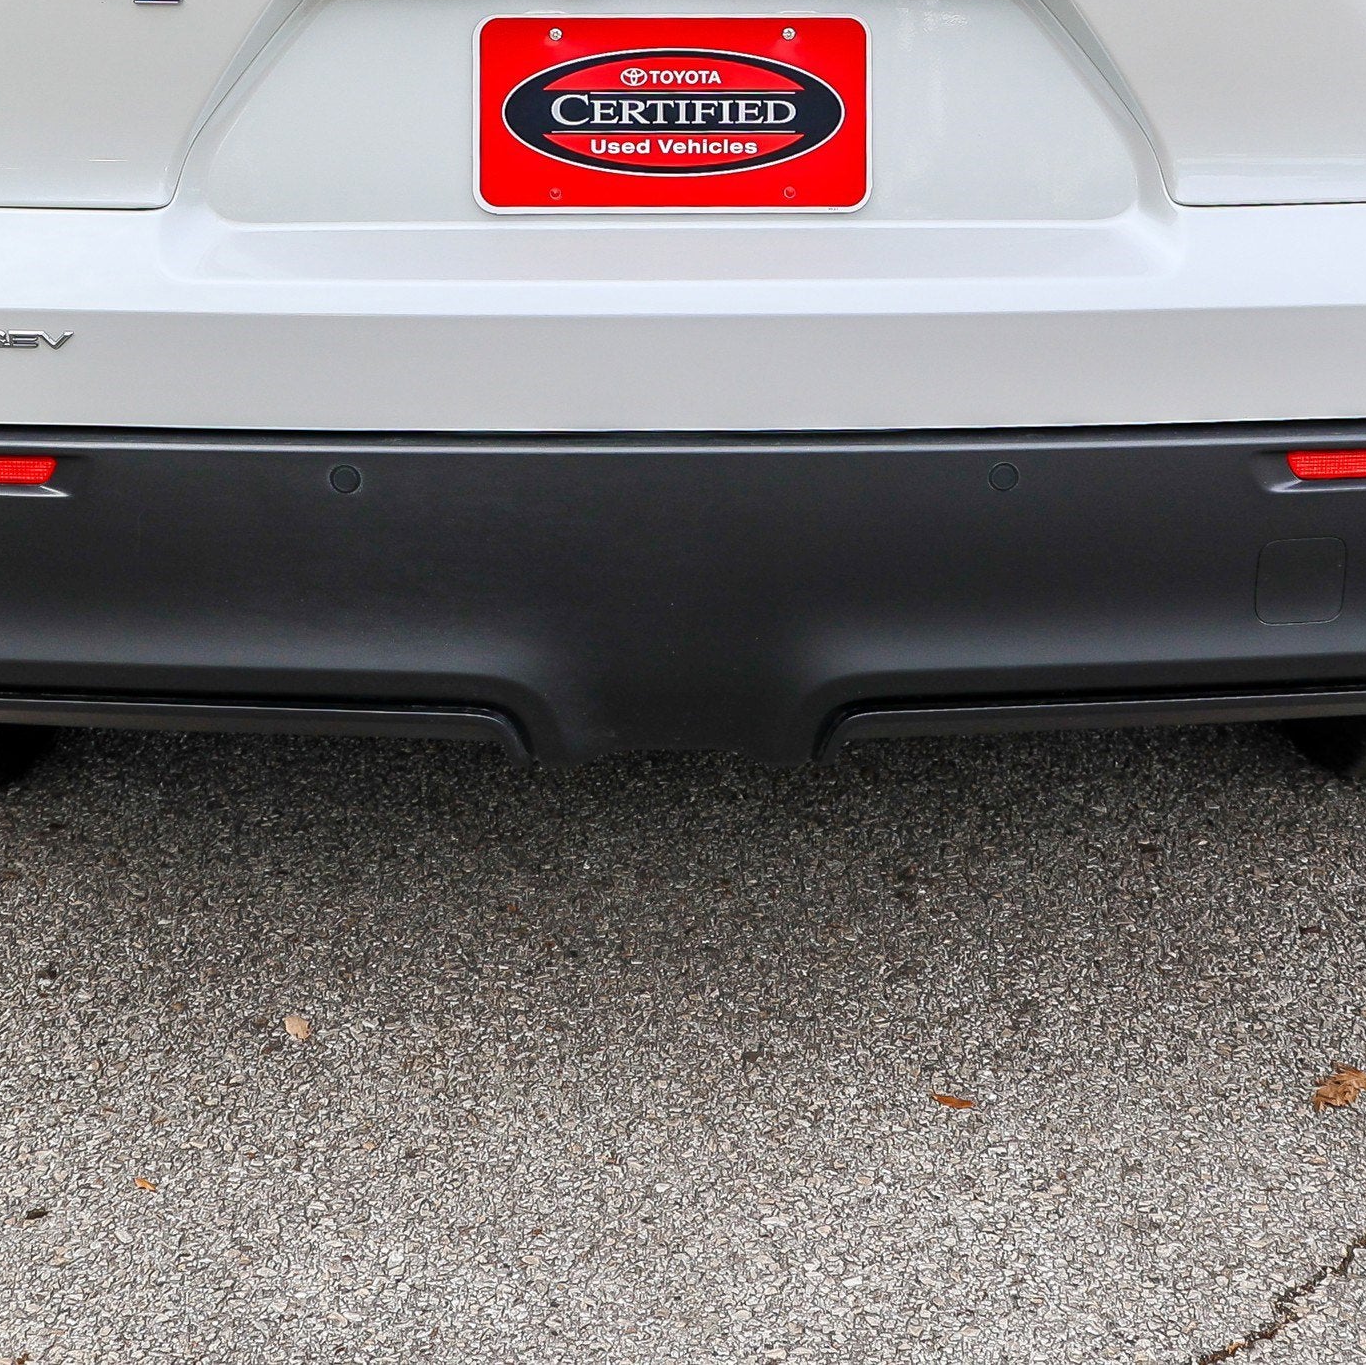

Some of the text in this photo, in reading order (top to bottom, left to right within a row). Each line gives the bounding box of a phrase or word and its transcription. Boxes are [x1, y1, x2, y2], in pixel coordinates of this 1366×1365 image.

[649, 70, 722, 85] TOYOTA
[550, 93, 797, 126] CERTIFIED
[589, 138, 758, 155] Used Vehicles
